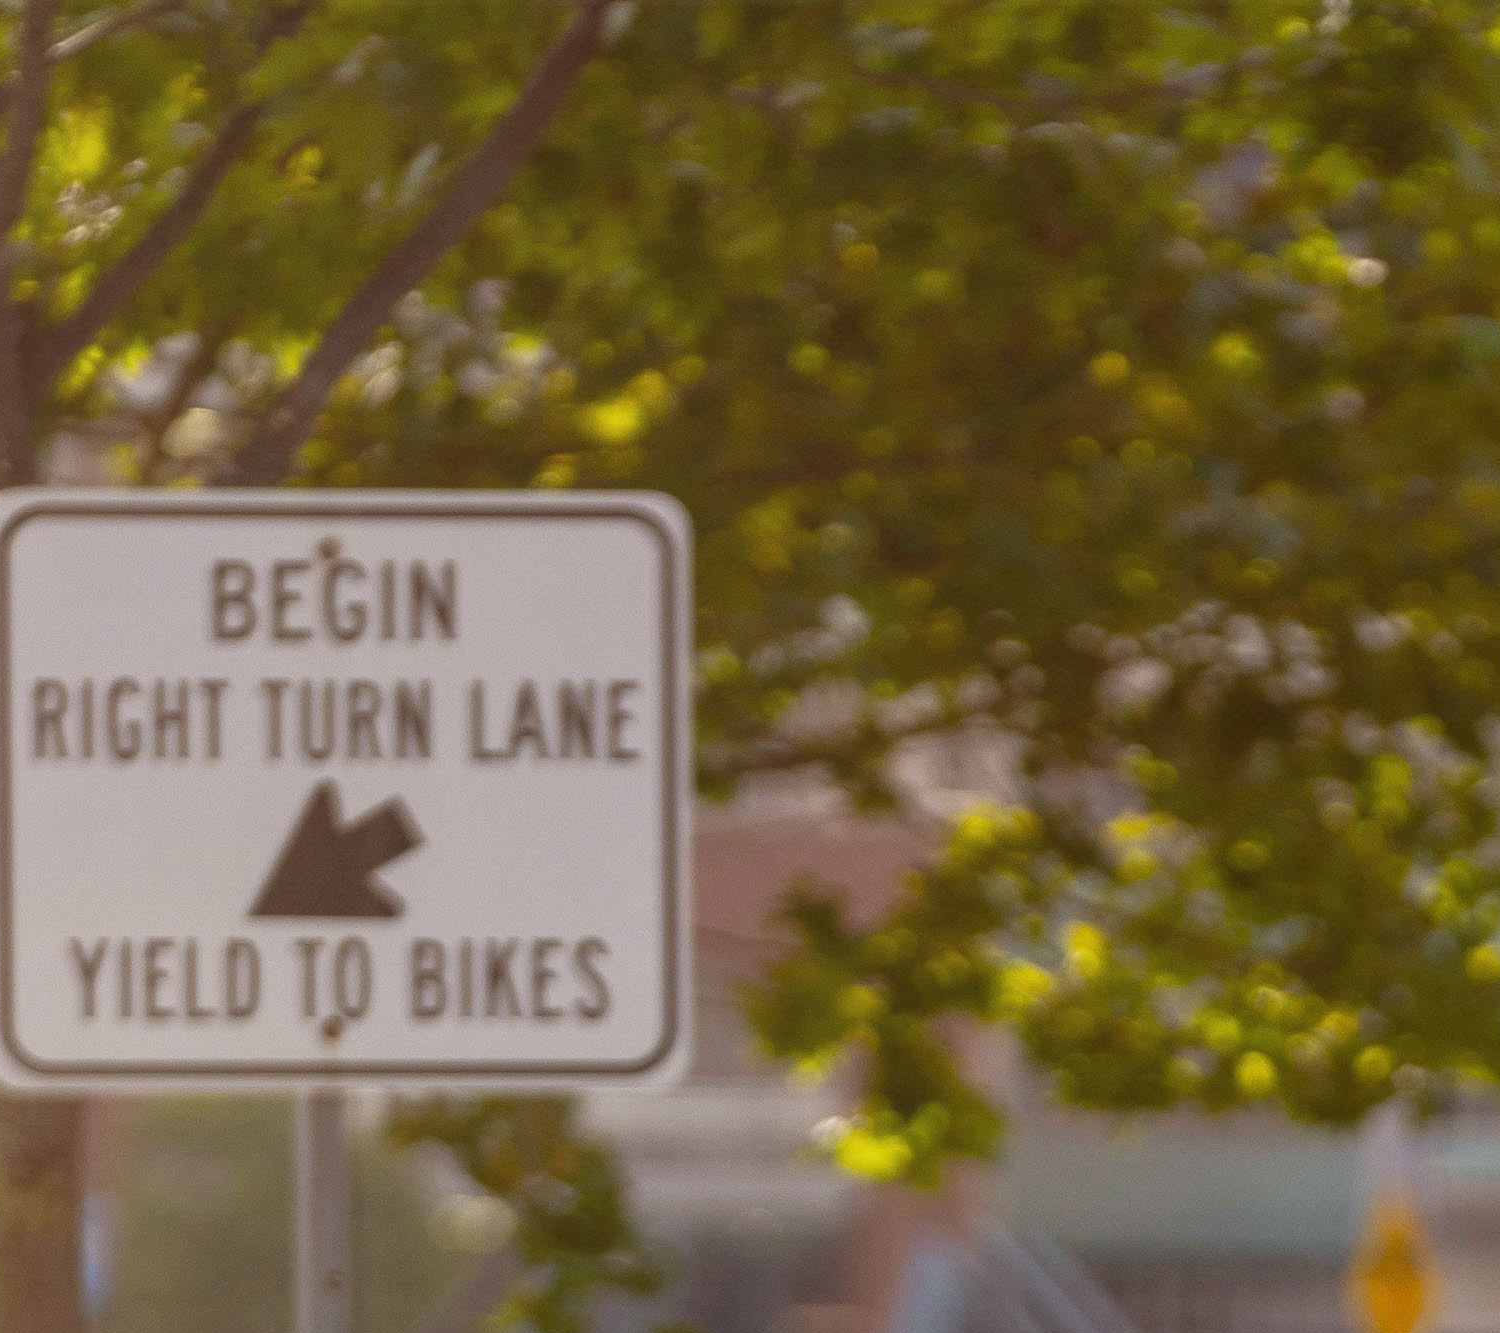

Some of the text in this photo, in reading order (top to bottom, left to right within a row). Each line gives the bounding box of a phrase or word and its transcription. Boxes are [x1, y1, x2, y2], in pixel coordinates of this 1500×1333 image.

[209, 557, 459, 644] BEGIN
[31, 675, 641, 763] RIGHT TURN LANE
[68, 935, 613, 1022] YIELD TO BIKES
